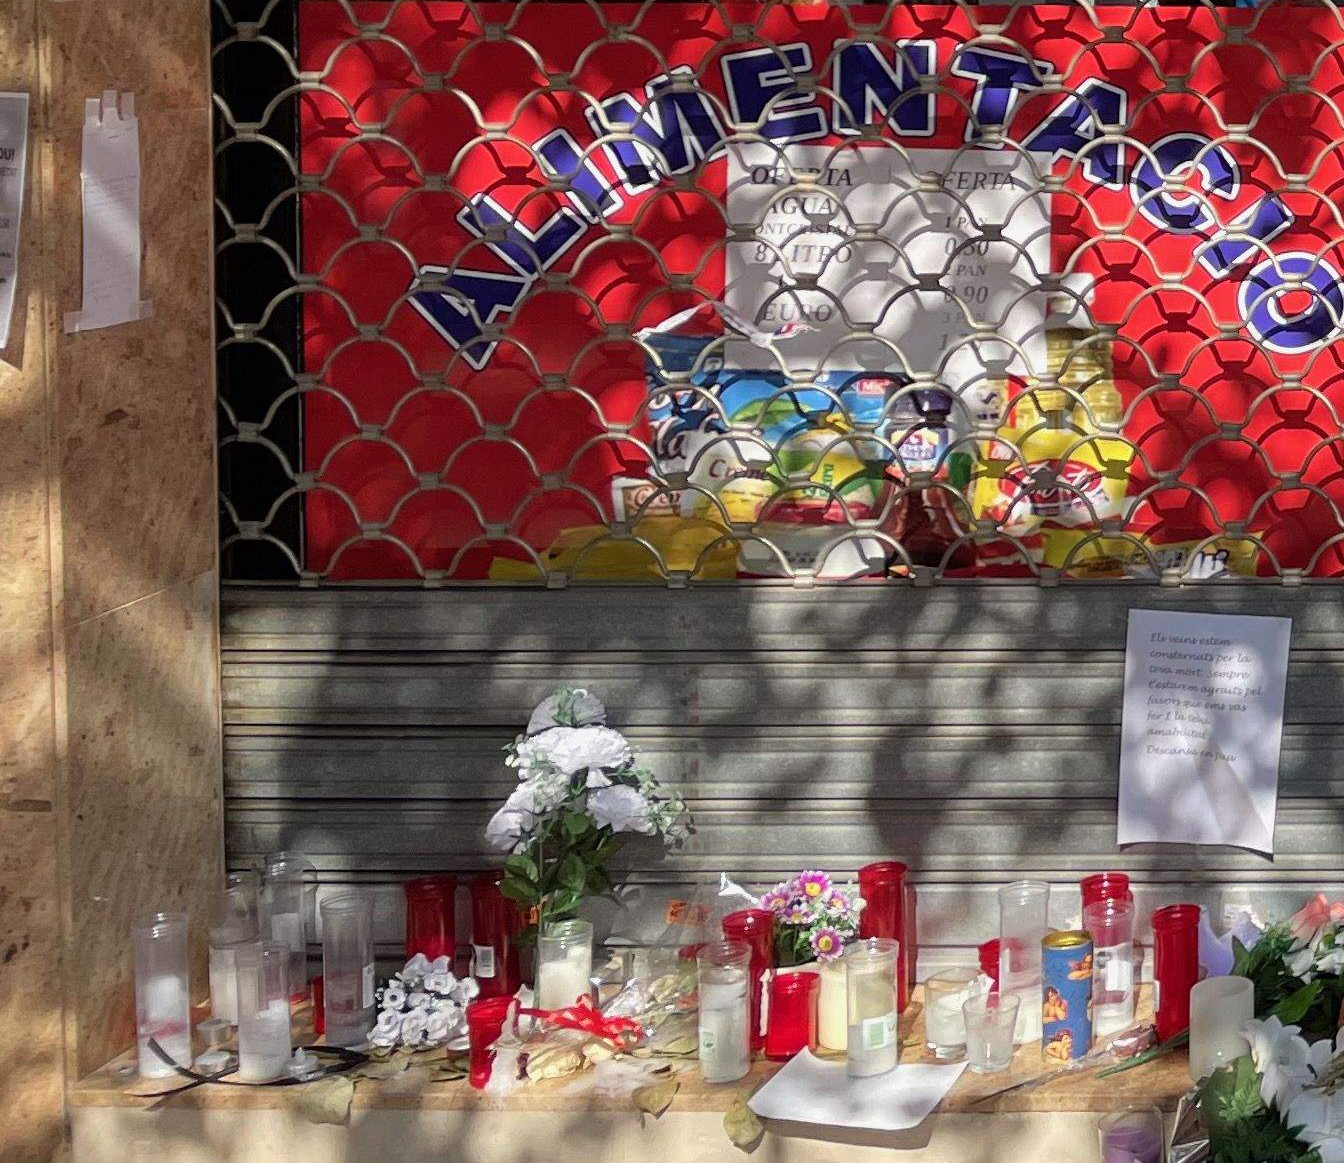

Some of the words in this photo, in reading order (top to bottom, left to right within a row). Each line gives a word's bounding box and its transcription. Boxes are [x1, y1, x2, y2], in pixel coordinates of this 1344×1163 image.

[923, 169, 1017, 191] FERTA
[768, 196, 835, 217] AGUA
[957, 264, 987, 278] PAN
[763, 302, 833, 322] EURO
